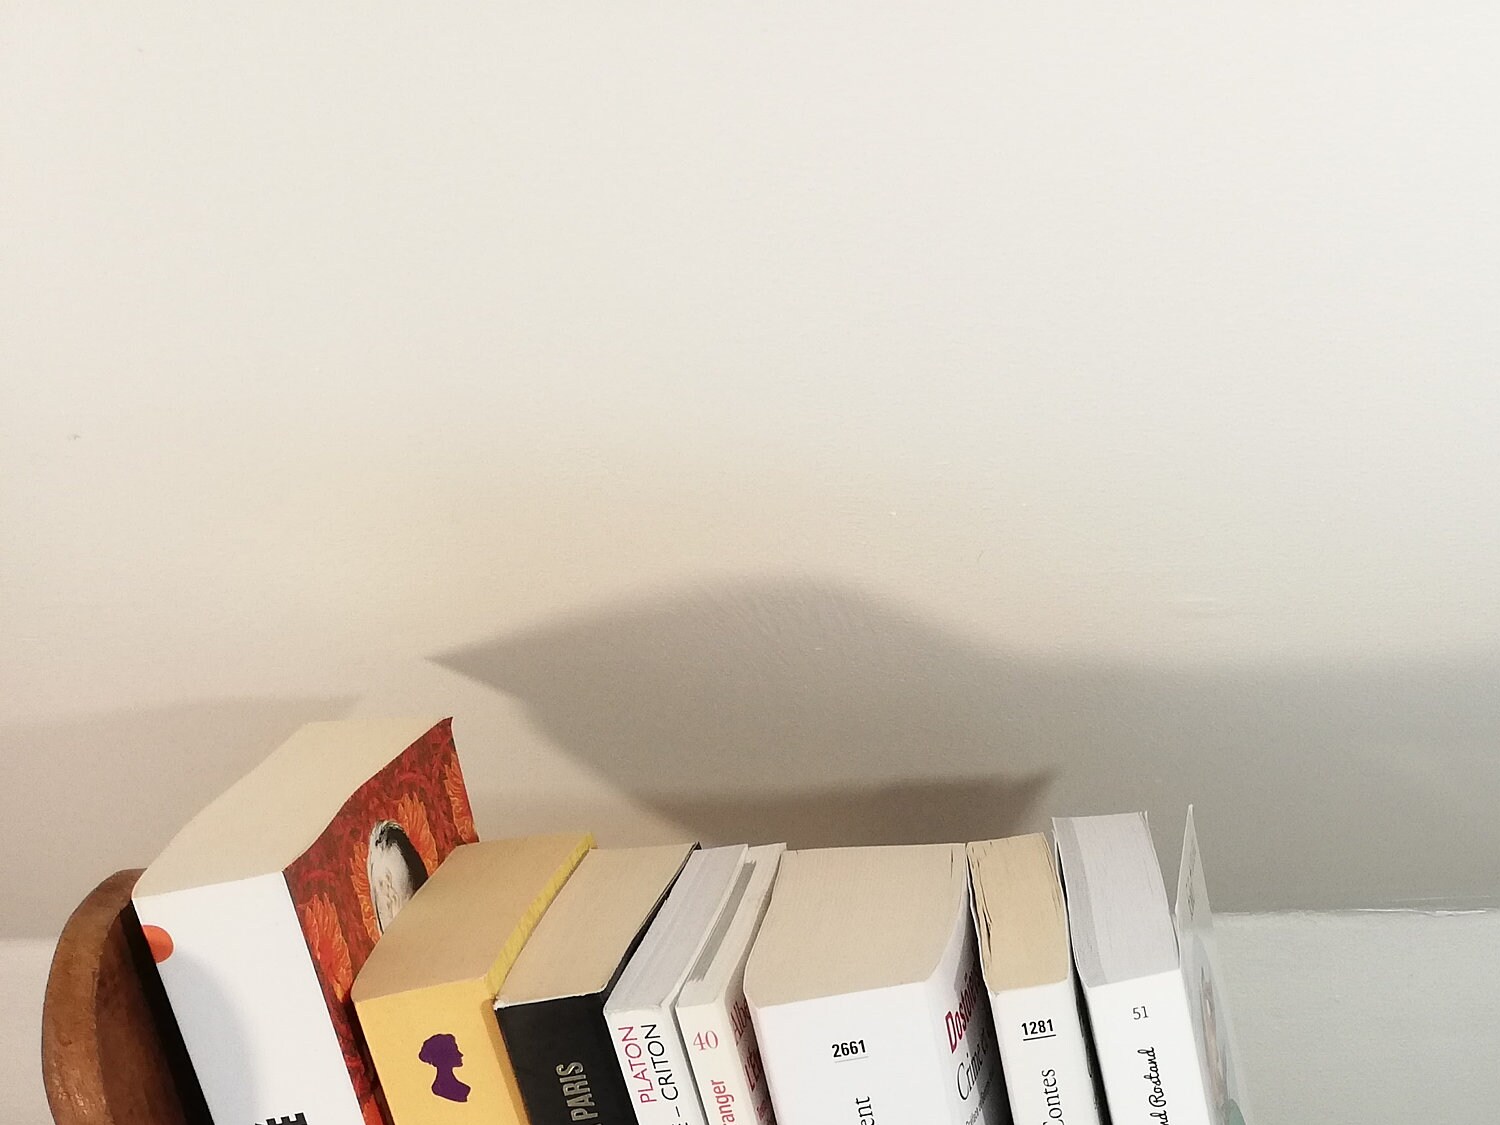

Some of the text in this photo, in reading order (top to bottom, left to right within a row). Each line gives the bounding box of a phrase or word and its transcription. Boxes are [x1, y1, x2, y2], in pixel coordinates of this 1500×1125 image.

[1021, 1019, 1054, 1036] 1281
[1132, 1005, 1149, 1021] 51
[618, 1026, 657, 1105] PLATON
[640, 1024, 680, 1101] CRITON
[831, 1039, 867, 1058] 2661
[1137, 1046, 1167, 1108] Rostand
[557, 1061, 599, 1123] PARIS
